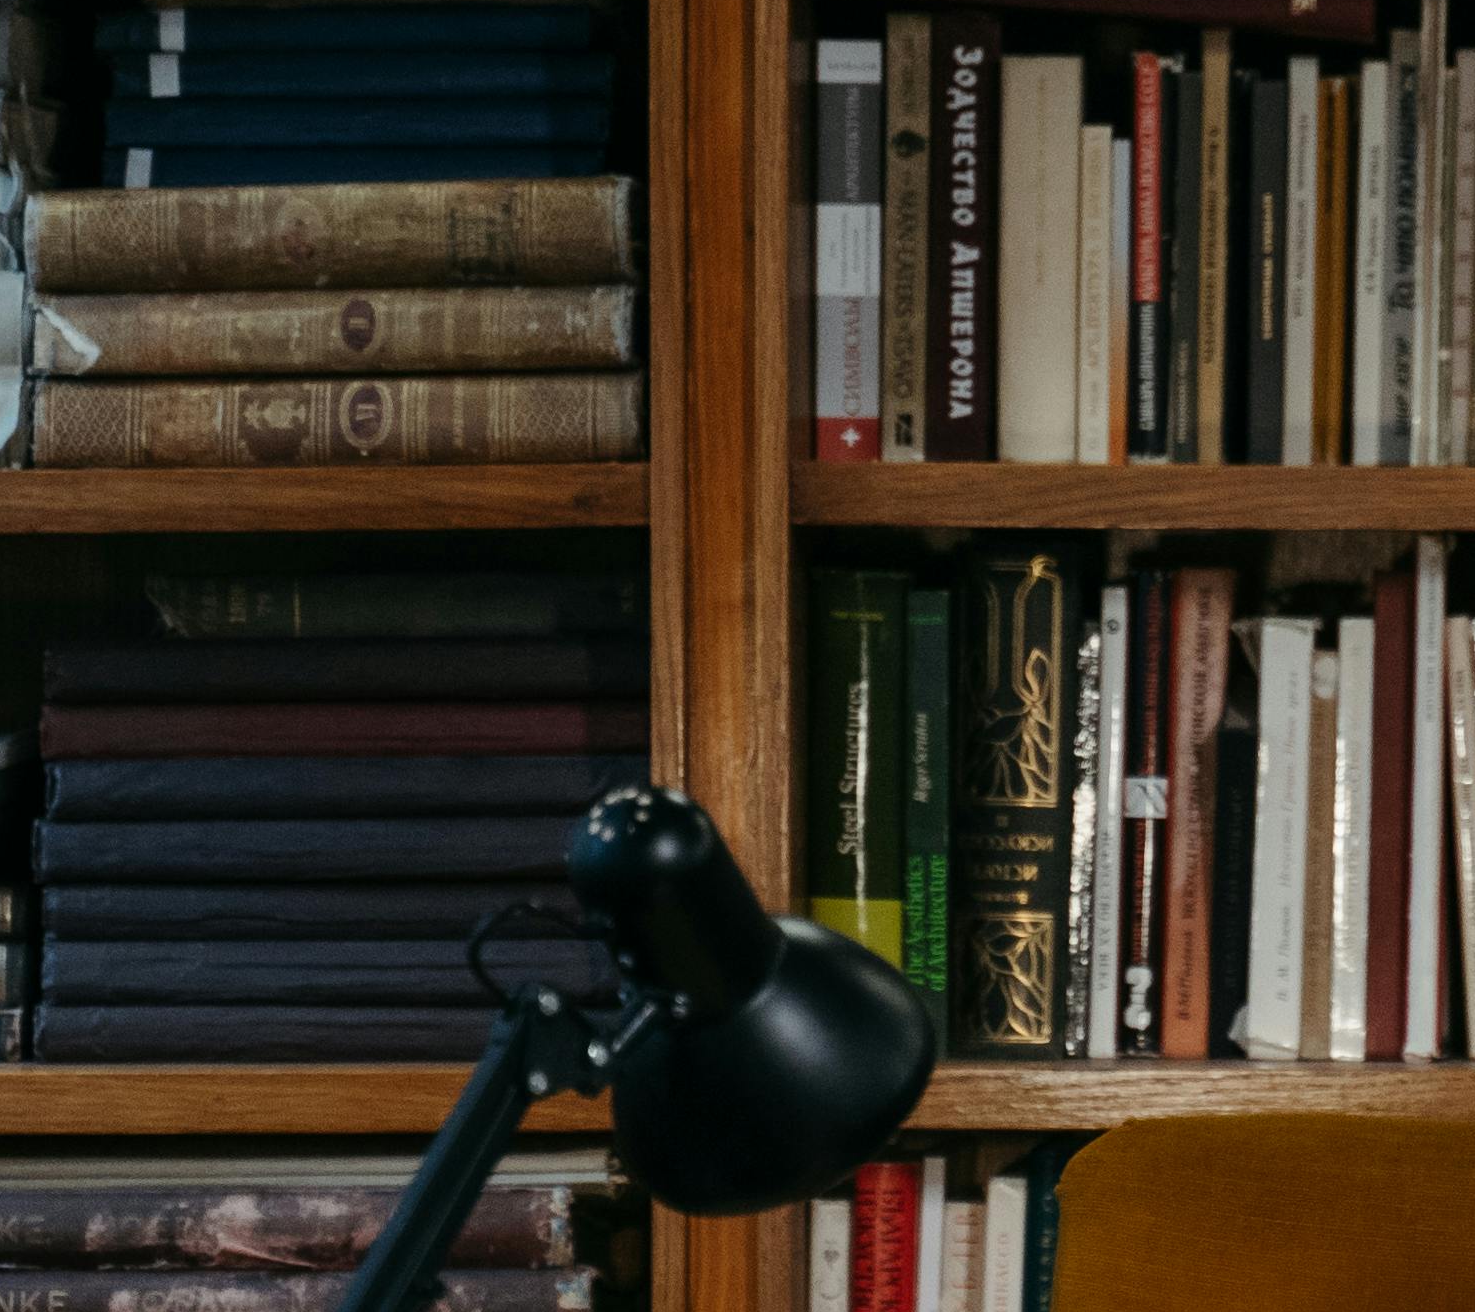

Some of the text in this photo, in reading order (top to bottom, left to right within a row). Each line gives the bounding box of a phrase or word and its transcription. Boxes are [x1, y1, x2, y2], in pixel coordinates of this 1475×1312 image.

[947, 45, 985, 420] ЗОДЧЕСТВО АПШЕРОНА
[829, 295, 873, 418] СИМВОЛЫ
[837, 797, 863, 856] Steel
[907, 855, 924, 947] Aesthetics
[930, 855, 946, 971] Architecture
